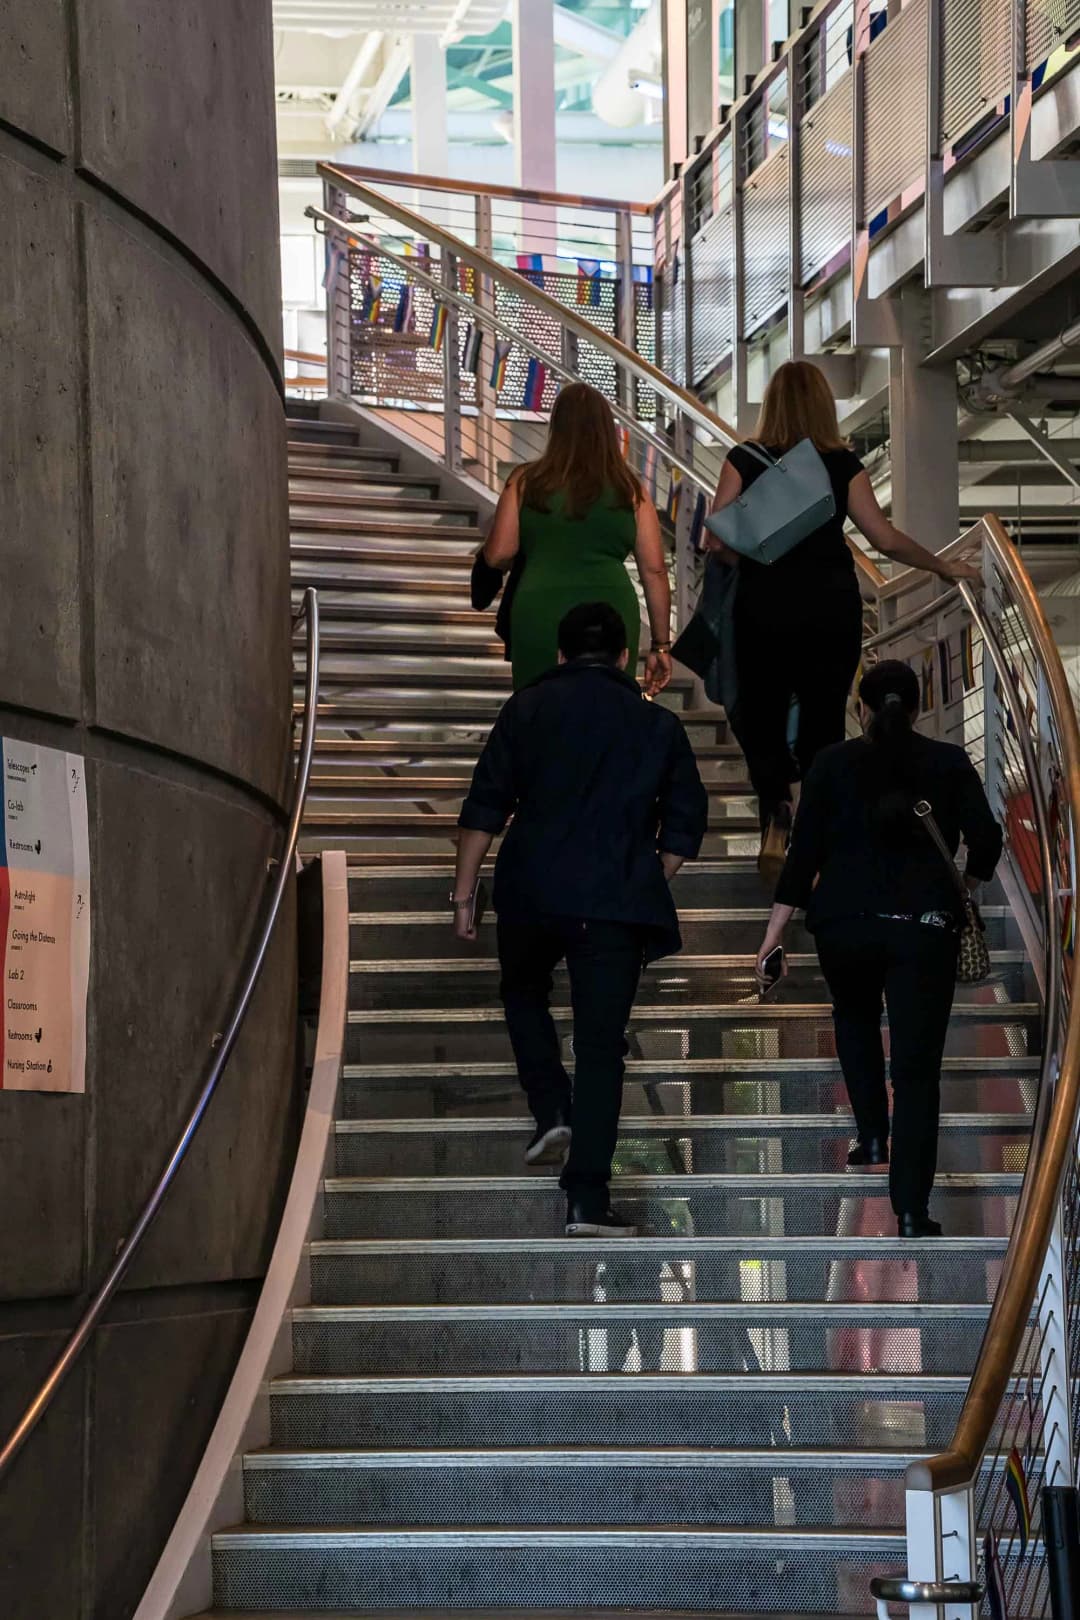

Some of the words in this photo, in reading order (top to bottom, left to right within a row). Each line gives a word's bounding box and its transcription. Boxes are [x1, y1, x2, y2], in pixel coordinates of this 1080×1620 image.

[8, 799, 24, 811] Co-lab
[9, 839, 33, 852] Restrooms
[12, 929, 28, 943] Going
[29, 930, 38, 941] the
[8, 969, 19, 980] Lab
[20, 969, 25, 980] 2
[8, 999, 38, 1011] Classrooms
[8, 1029, 33, 1041] Restrooms
[7, 1059, 25, 1072] Nursing
[26, 1060, 47, 1071] Station
